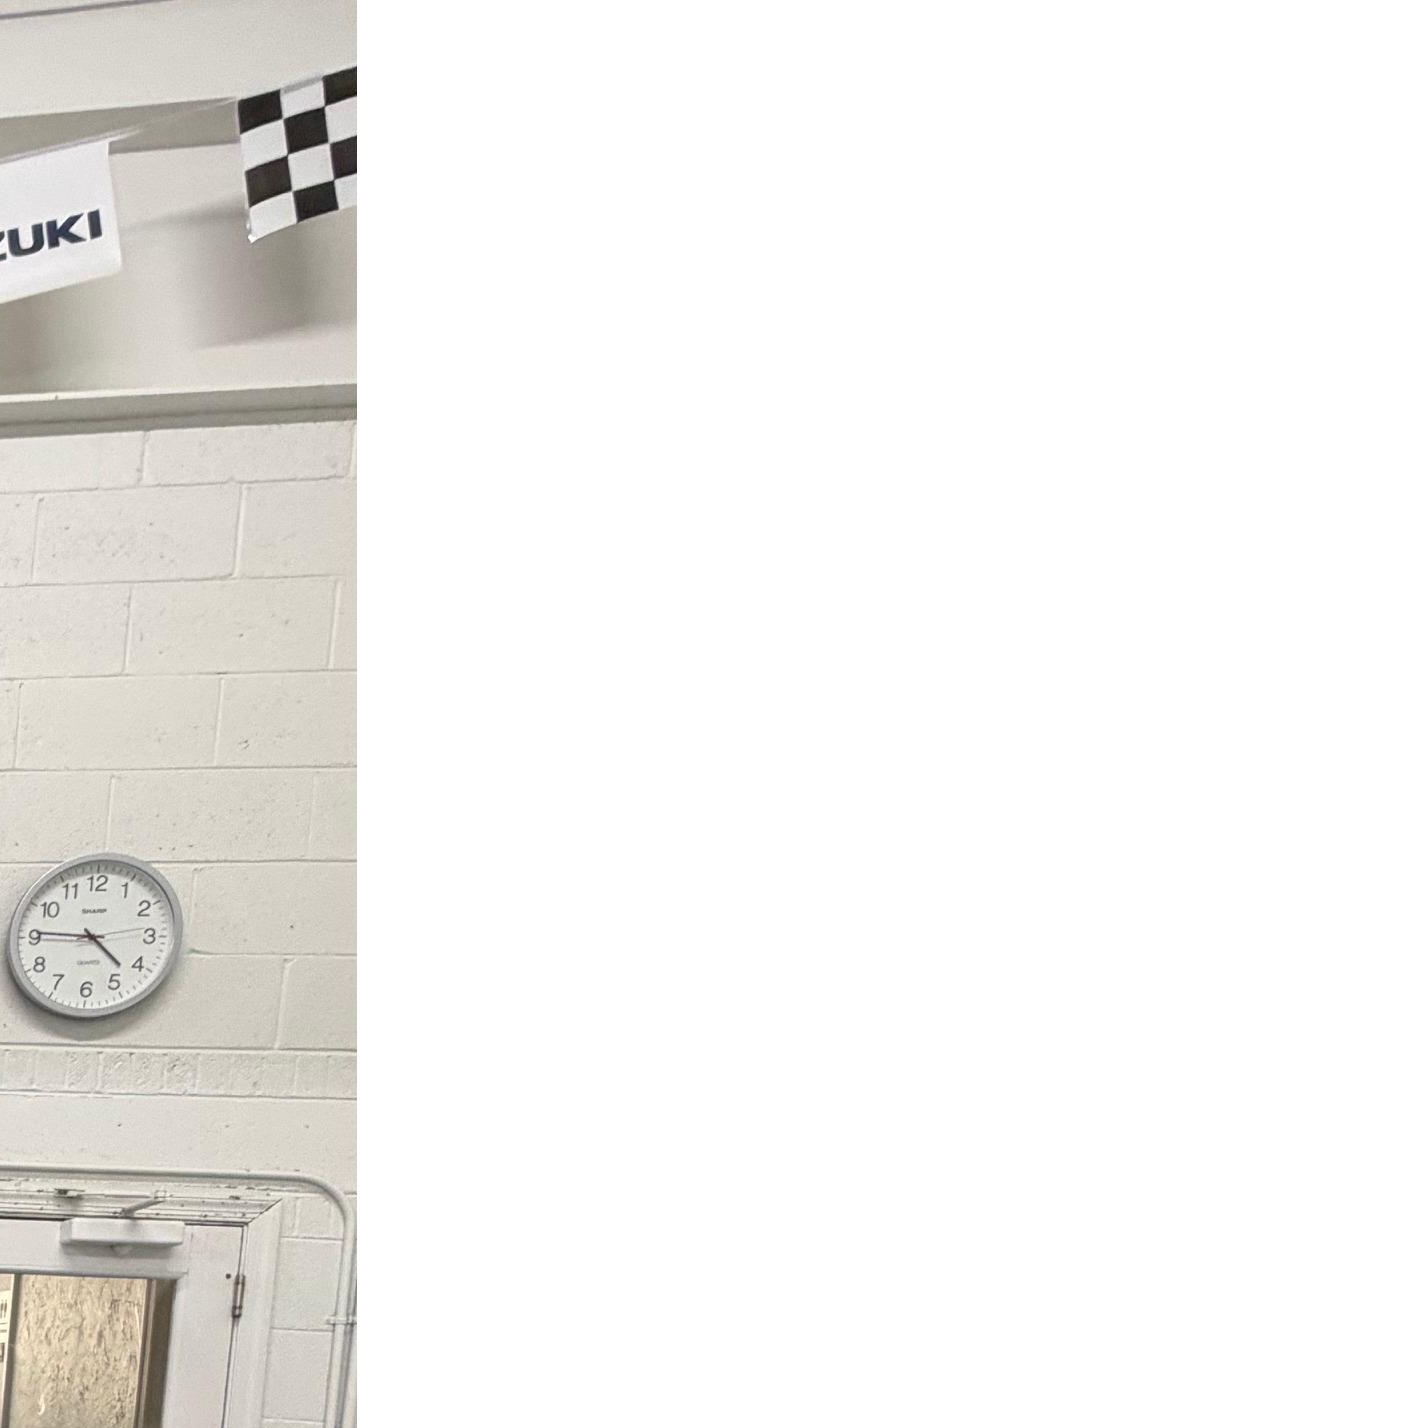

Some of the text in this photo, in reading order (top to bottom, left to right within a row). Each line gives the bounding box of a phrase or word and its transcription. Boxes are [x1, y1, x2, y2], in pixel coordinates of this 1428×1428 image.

[62, 883, 78, 900] 11
[87, 875, 108, 892] 12
[121, 882, 129, 898] 1
[40, 901, 60, 918] 10
[137, 900, 151, 917] 2
[28, 929, 41, 945] 9
[143, 928, 156, 944] 3
[33, 956, 46, 973] 8
[131, 956, 144, 972] 4
[53, 974, 65, 990] 7
[80, 981, 93, 998] 6
[108, 974, 121, 990] 5
